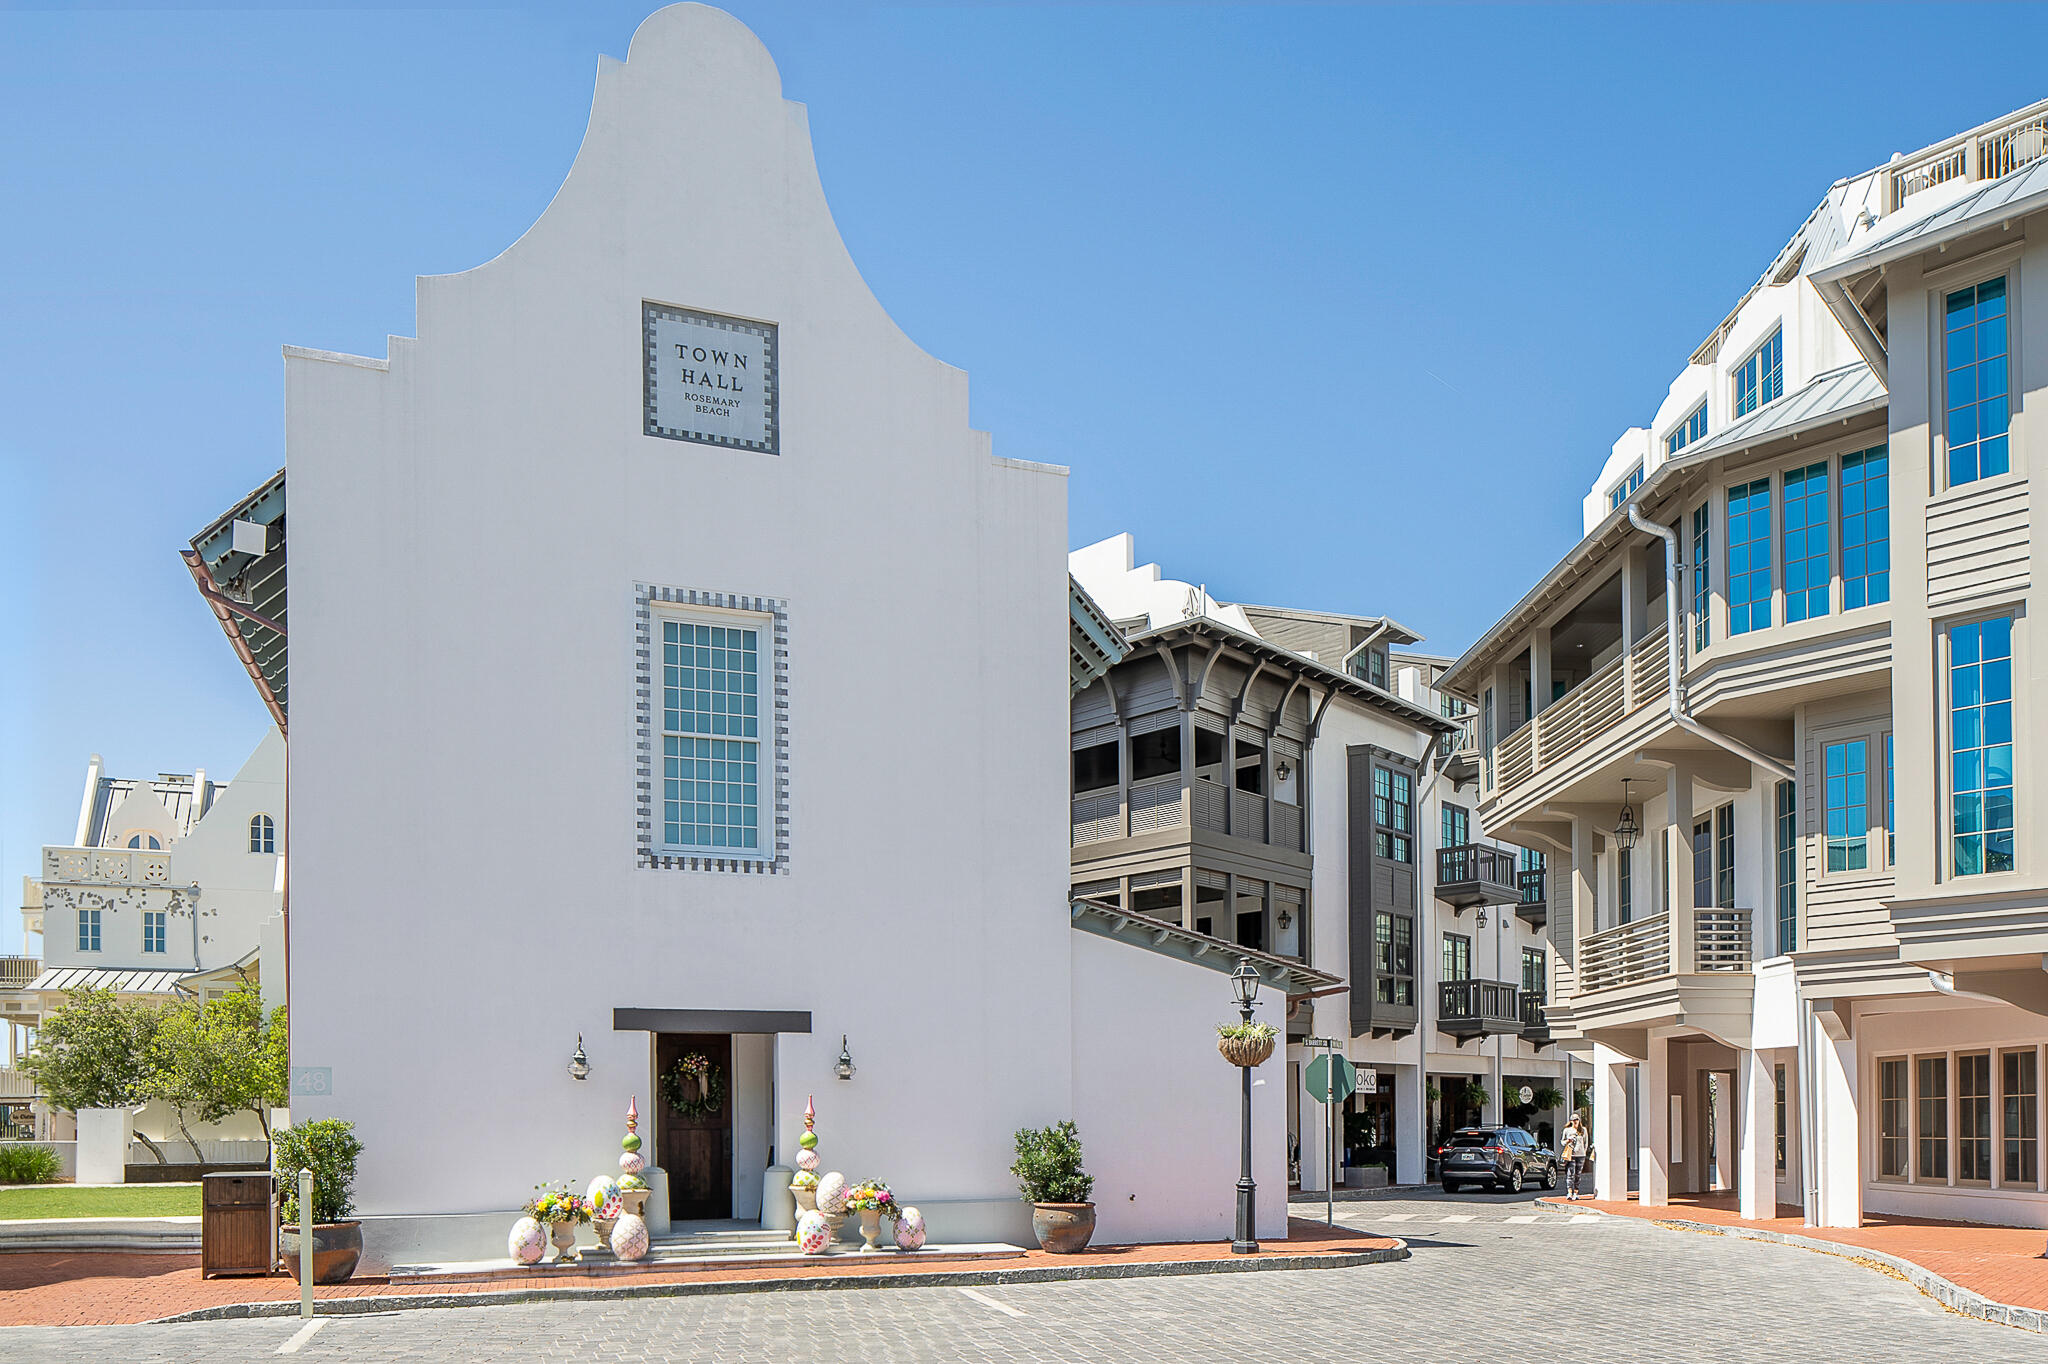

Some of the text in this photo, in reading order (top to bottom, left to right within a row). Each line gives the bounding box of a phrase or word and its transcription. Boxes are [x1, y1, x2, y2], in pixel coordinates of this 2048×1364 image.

[674, 343, 748, 370] TOWN
[681, 368, 743, 392] HALL
[684, 392, 741, 408] ROSEMARY
[695, 404, 730, 417] BEACH
[296, 1071, 327, 1092] 48
